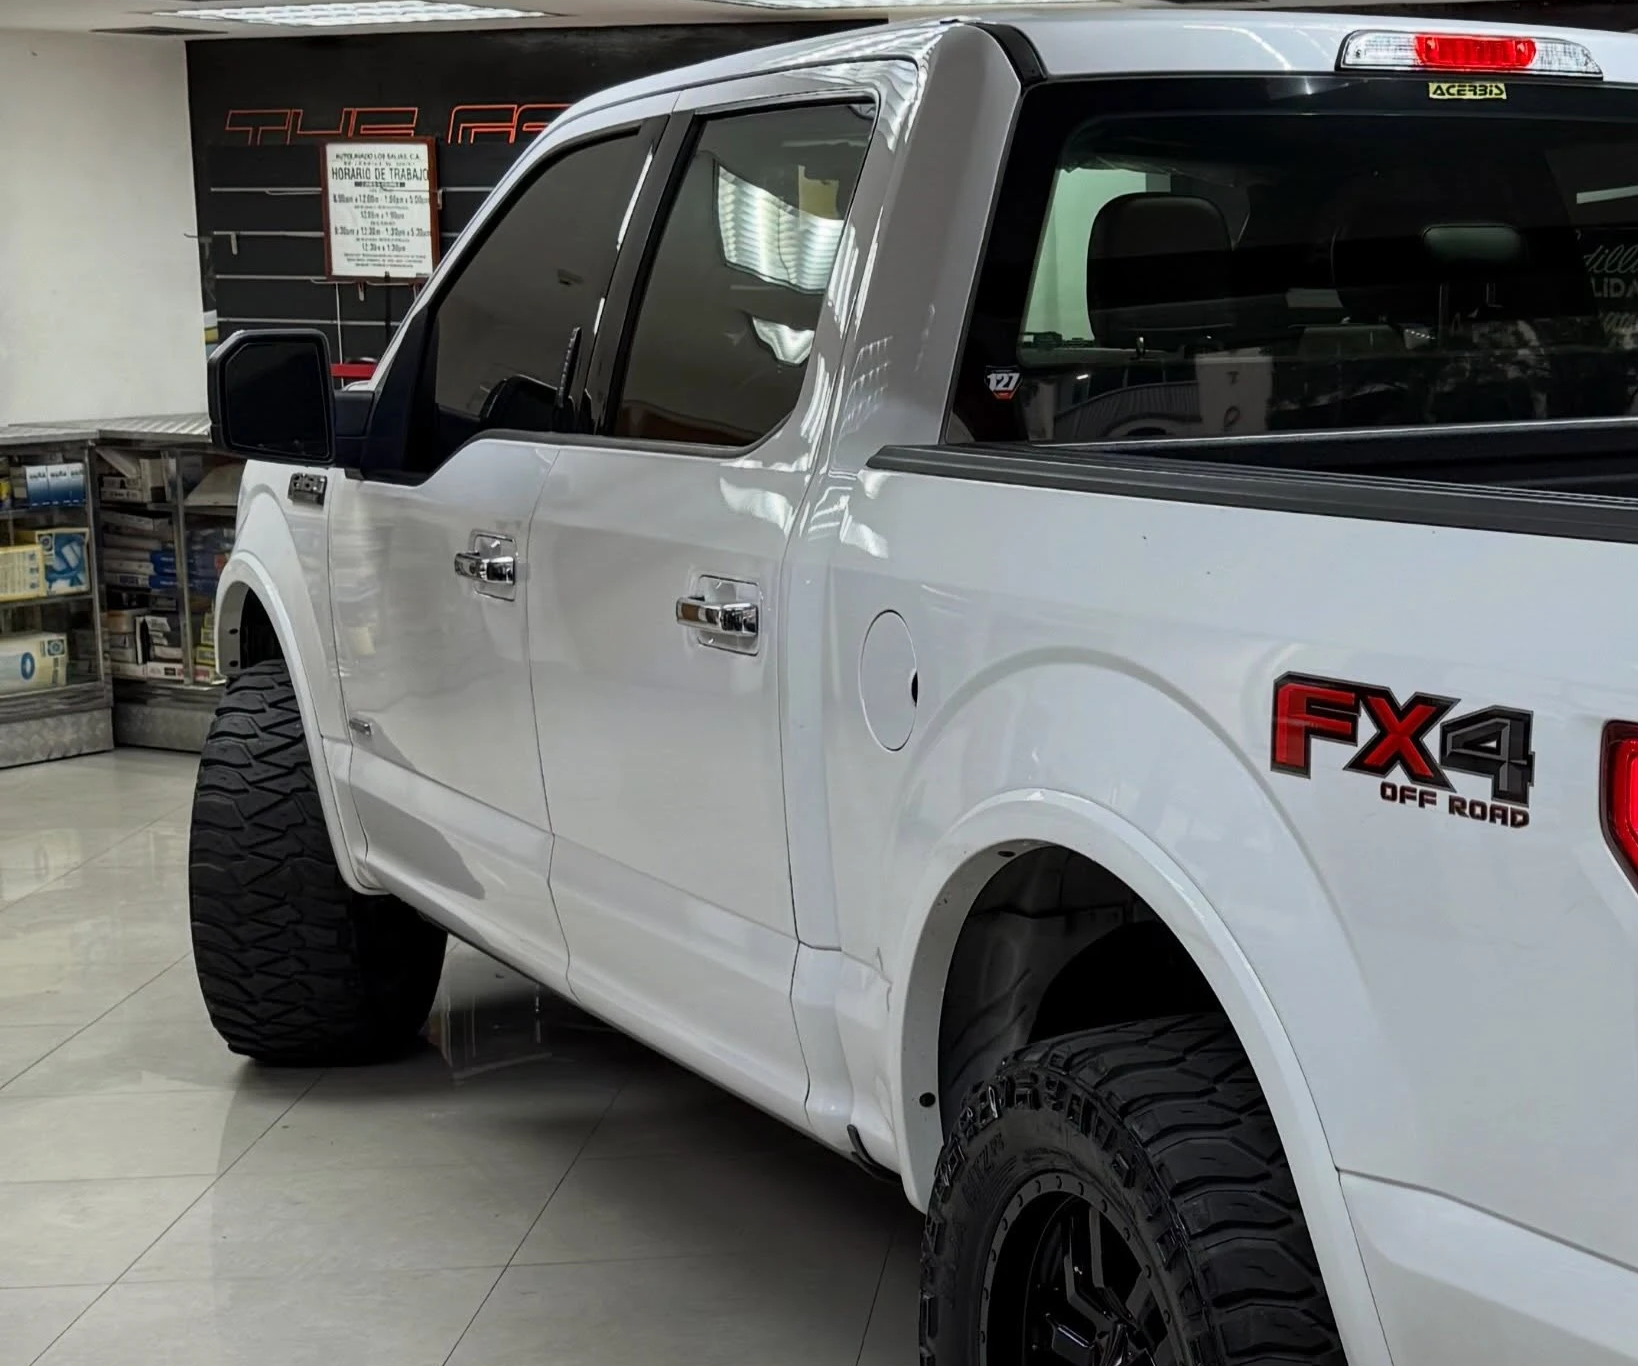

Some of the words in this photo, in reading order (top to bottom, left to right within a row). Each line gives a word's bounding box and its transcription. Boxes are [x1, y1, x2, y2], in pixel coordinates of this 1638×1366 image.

[331, 167, 371, 180] HORARIO
[374, 167, 386, 180] DE
[389, 167, 429, 181] TRABAJO
[987, 372, 1020, 392] 127
[1269, 670, 1536, 808] FX4
[1379, 781, 1438, 810] OFF
[1448, 792, 1531, 829] ROAD
